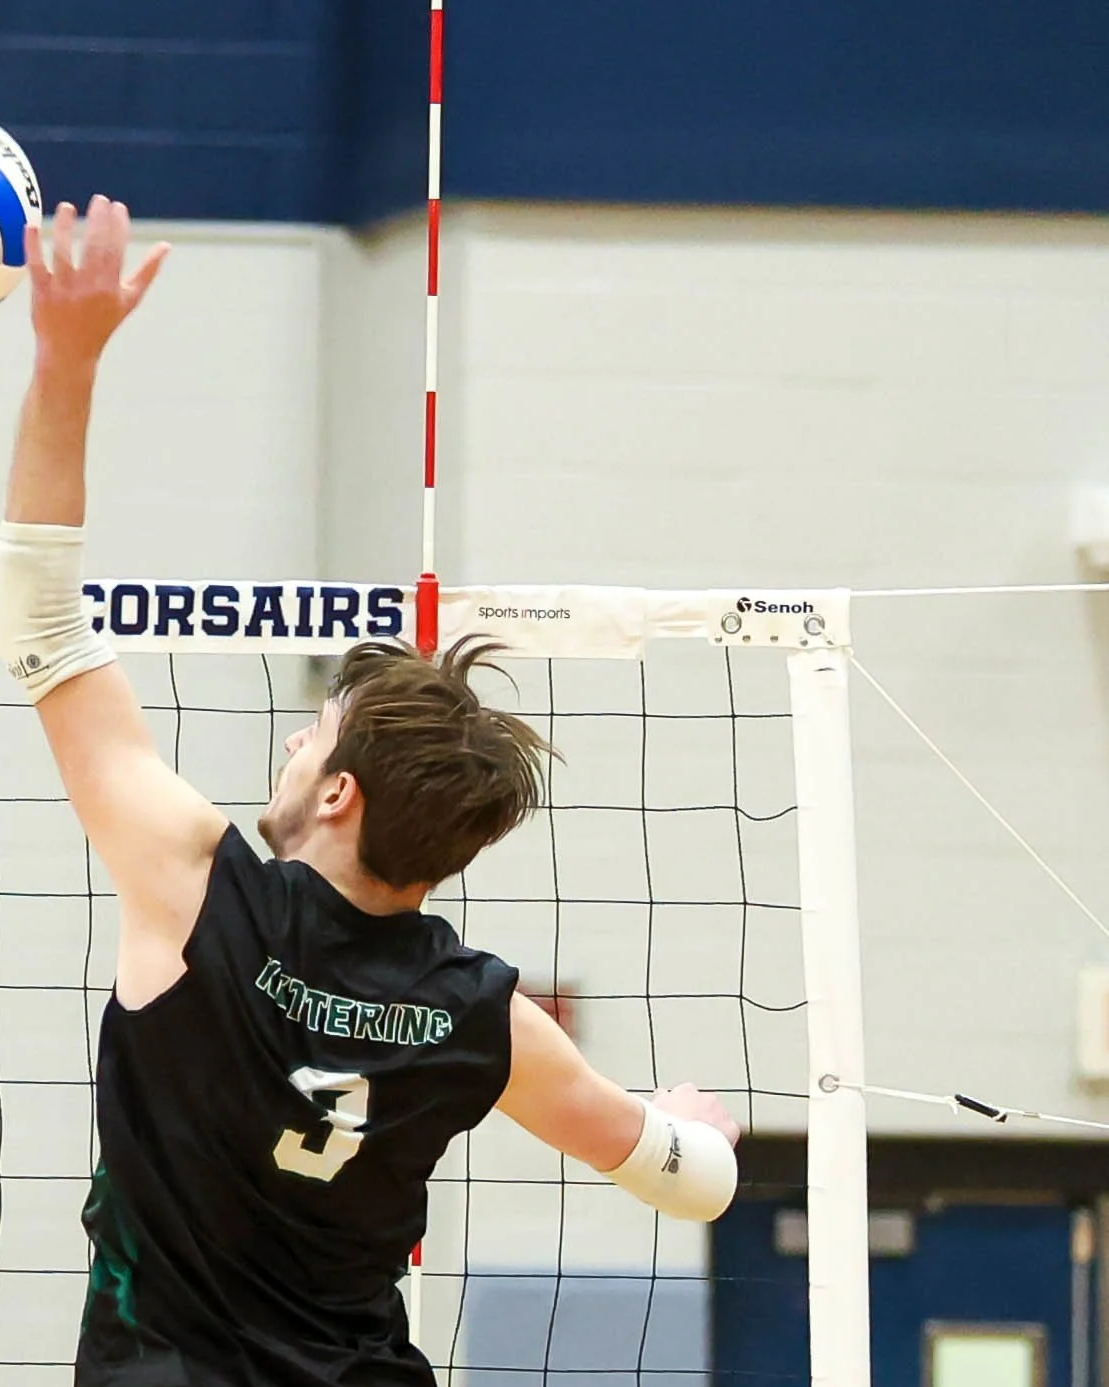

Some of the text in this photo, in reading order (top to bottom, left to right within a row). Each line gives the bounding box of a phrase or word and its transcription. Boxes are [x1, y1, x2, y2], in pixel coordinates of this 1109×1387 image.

[478, 606, 571, 621] sports imports
[754, 600, 814, 614] Senoh
[272, 1066, 370, 1182] 3
